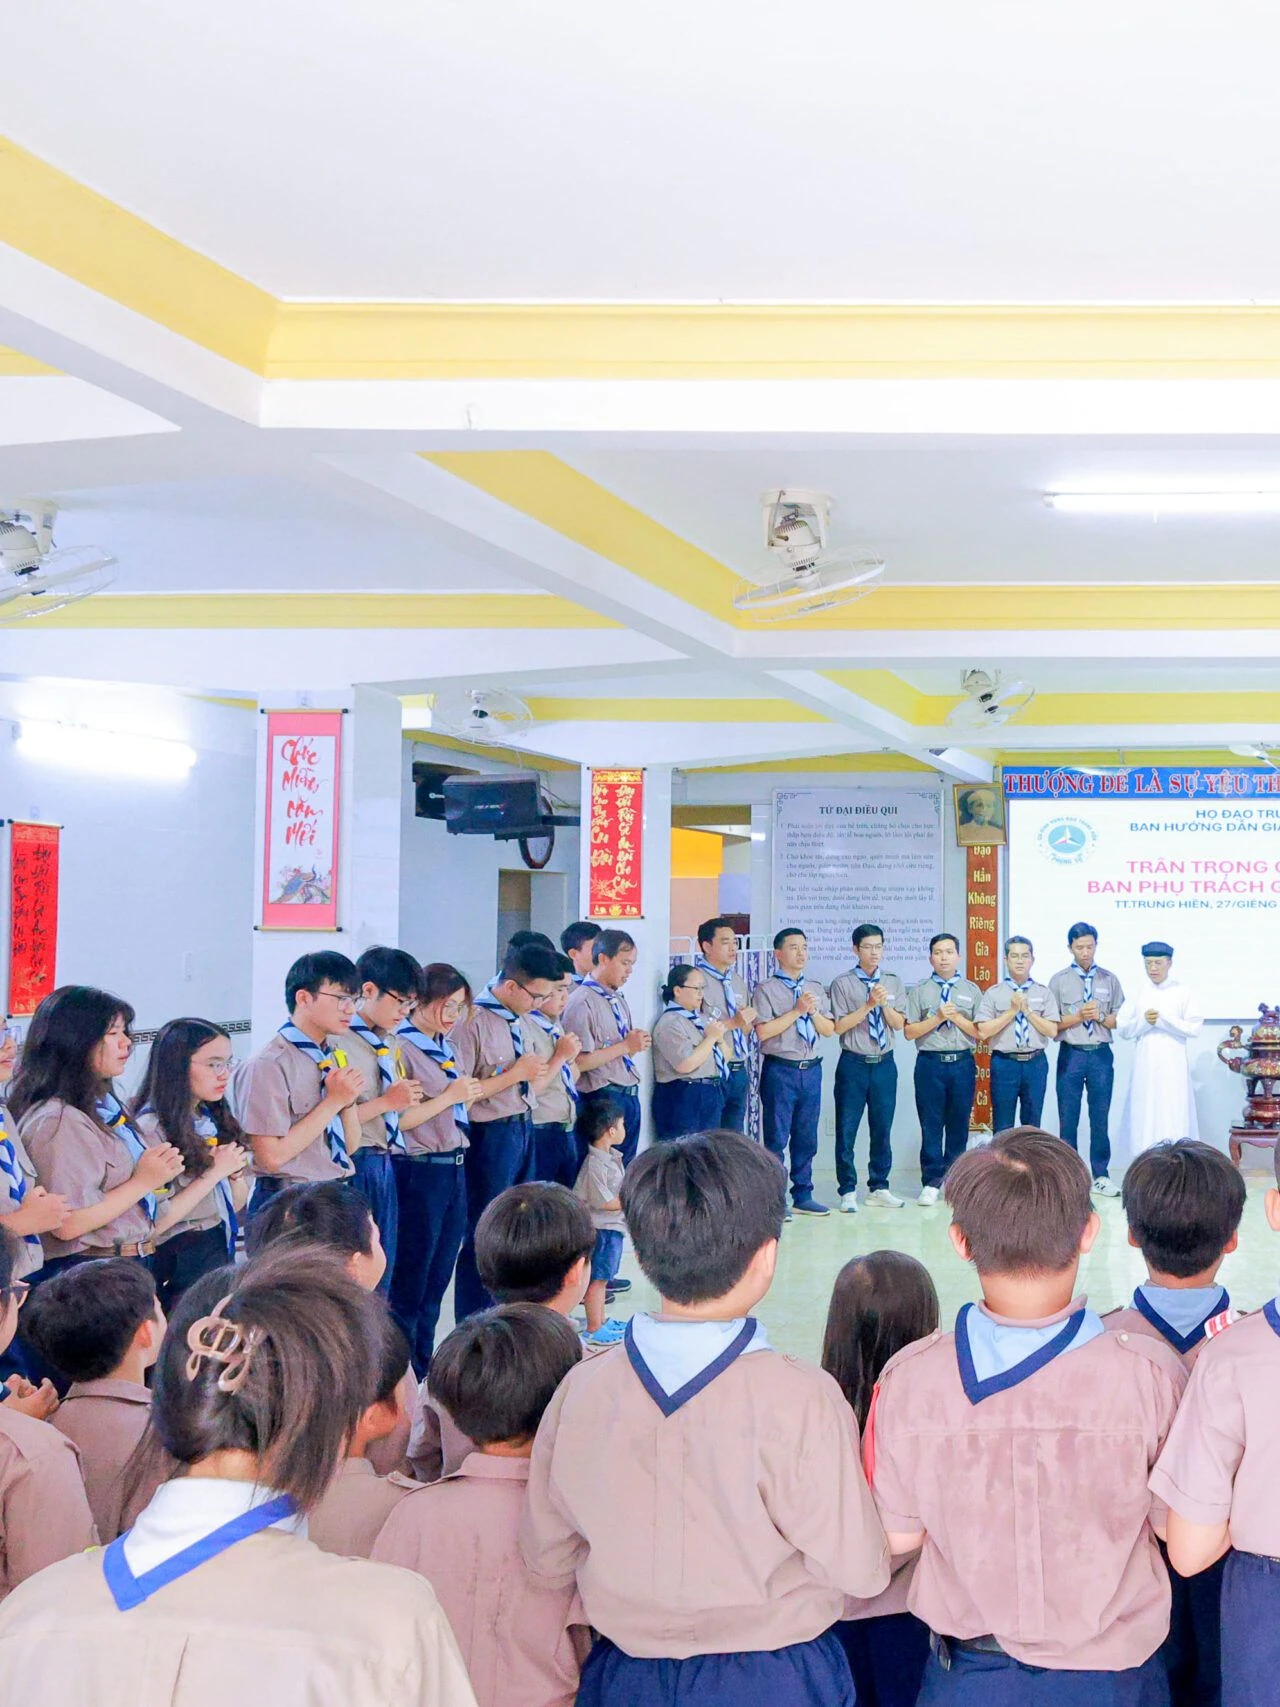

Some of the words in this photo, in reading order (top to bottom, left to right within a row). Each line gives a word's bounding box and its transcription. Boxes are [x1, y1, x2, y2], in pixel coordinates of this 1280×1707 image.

[1004, 770, 1093, 798] THƯỢNG
[1100, 769, 1129, 793] ĐẾ
[1134, 769, 1163, 793] LÀ
[1168, 770, 1200, 799] SỰ
[1205, 770, 1249, 794] YÊU
[819, 805, 834, 815] TỨ
[835, 806, 853, 816] ĐẠI
[855, 804, 879, 815] ĐIỀU
[880, 806, 898, 816] QUI
[1196, 809, 1218, 820] HỌ
[1222, 809, 1252, 820] ĐẠO
[1130, 822, 1160, 832] BAN
[1164, 820, 1222, 832] HƯỚNG
[1226, 819, 1258, 832] DẪN
[1126, 857, 1185, 874] TRÂN
[1190, 860, 1268, 876] TRỌNG
[1087, 880, 1132, 894] BAN
[1138, 880, 1184, 896] PHỤ
[1190, 876, 1264, 894] TRÁCH
[968, 892, 996, 907] Không
[1114, 899, 1175, 909] TT.TRUNG
[1179, 898, 1213, 909] HIỀN,
[1216, 898, 1277, 909] 27/GIÊNG
[969, 916, 995, 931] Riêng
[975, 941, 989, 956] Gia
[974, 966, 990, 981] Lão
[976, 1089, 988, 1106] Cả
